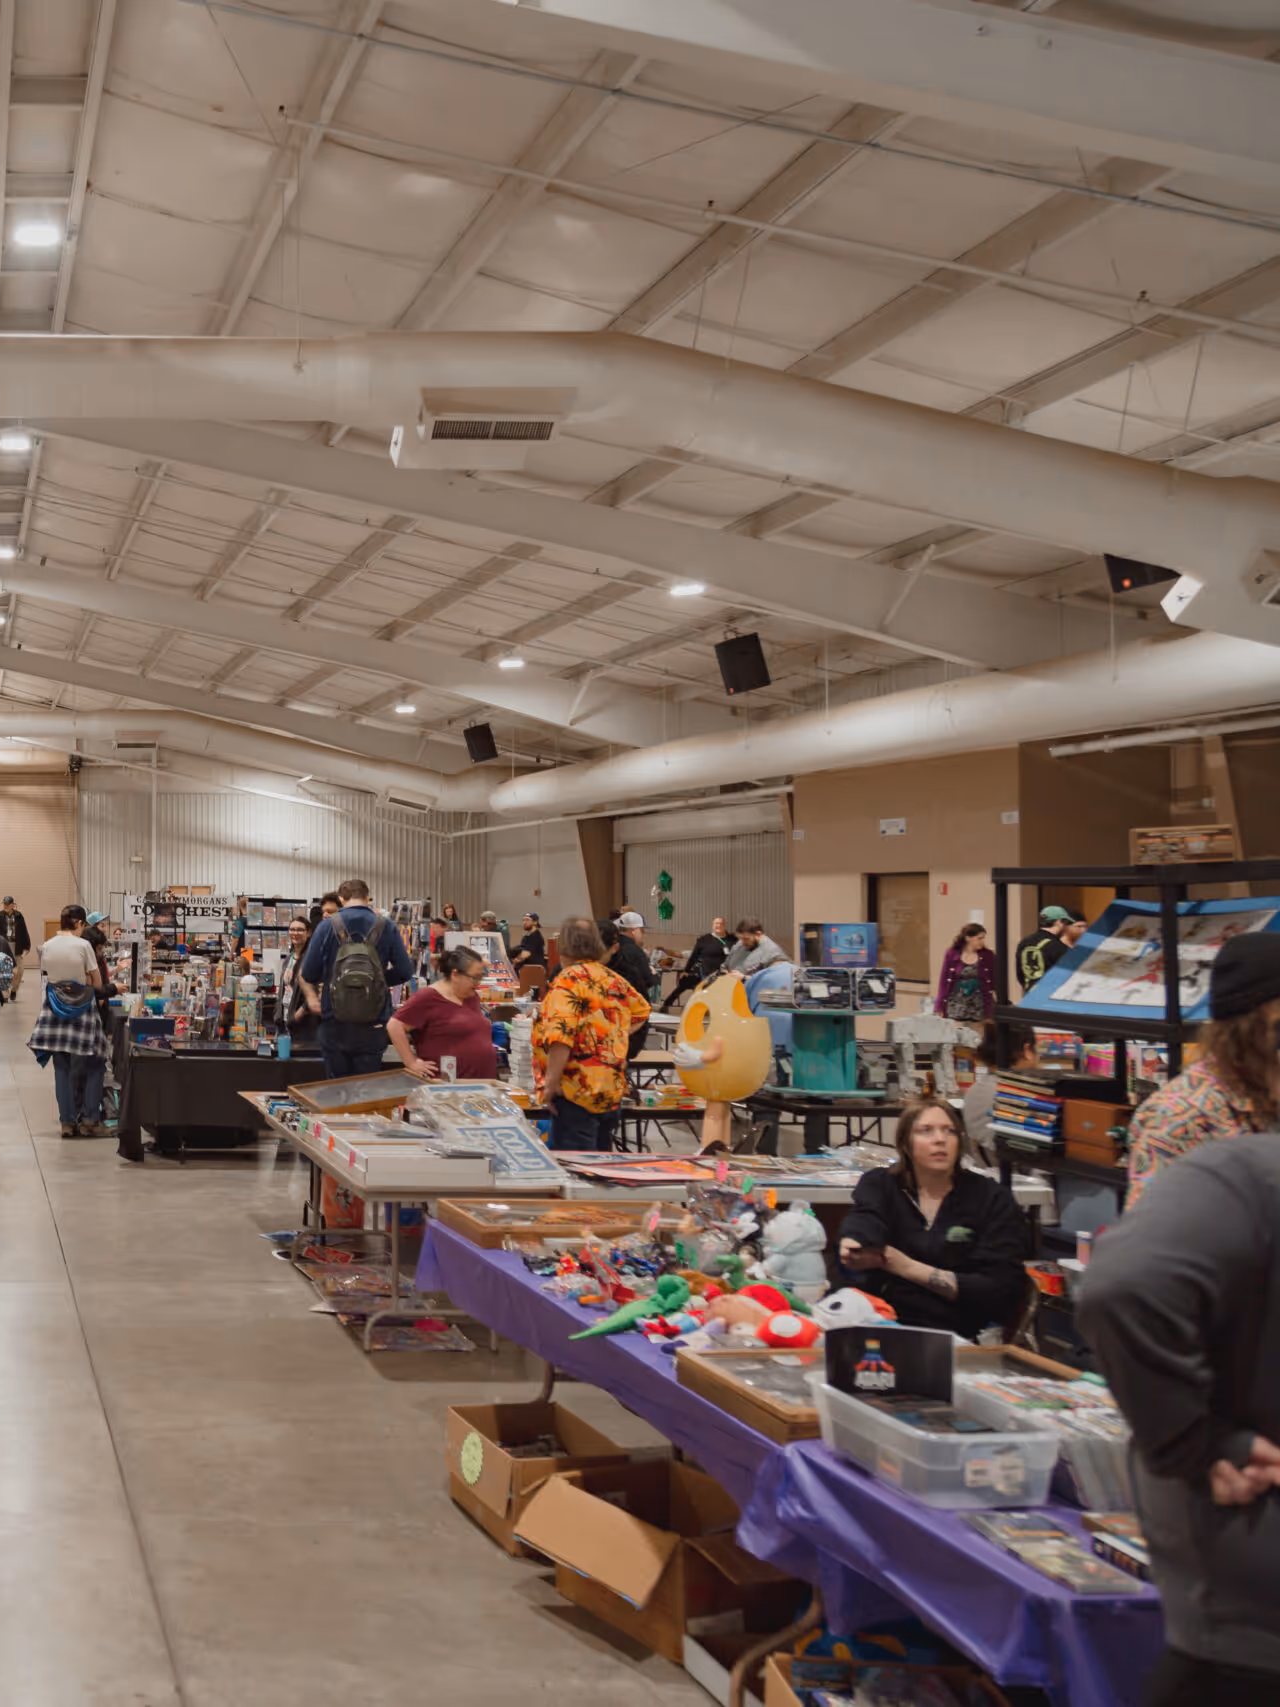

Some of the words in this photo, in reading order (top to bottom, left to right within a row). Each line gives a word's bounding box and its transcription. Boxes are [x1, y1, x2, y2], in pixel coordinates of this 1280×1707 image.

[182, 895, 228, 906] MORGANS
[131, 904, 158, 916] TO
[175, 905, 232, 917] CHEST
[493, 1128, 547, 1170] COLD
